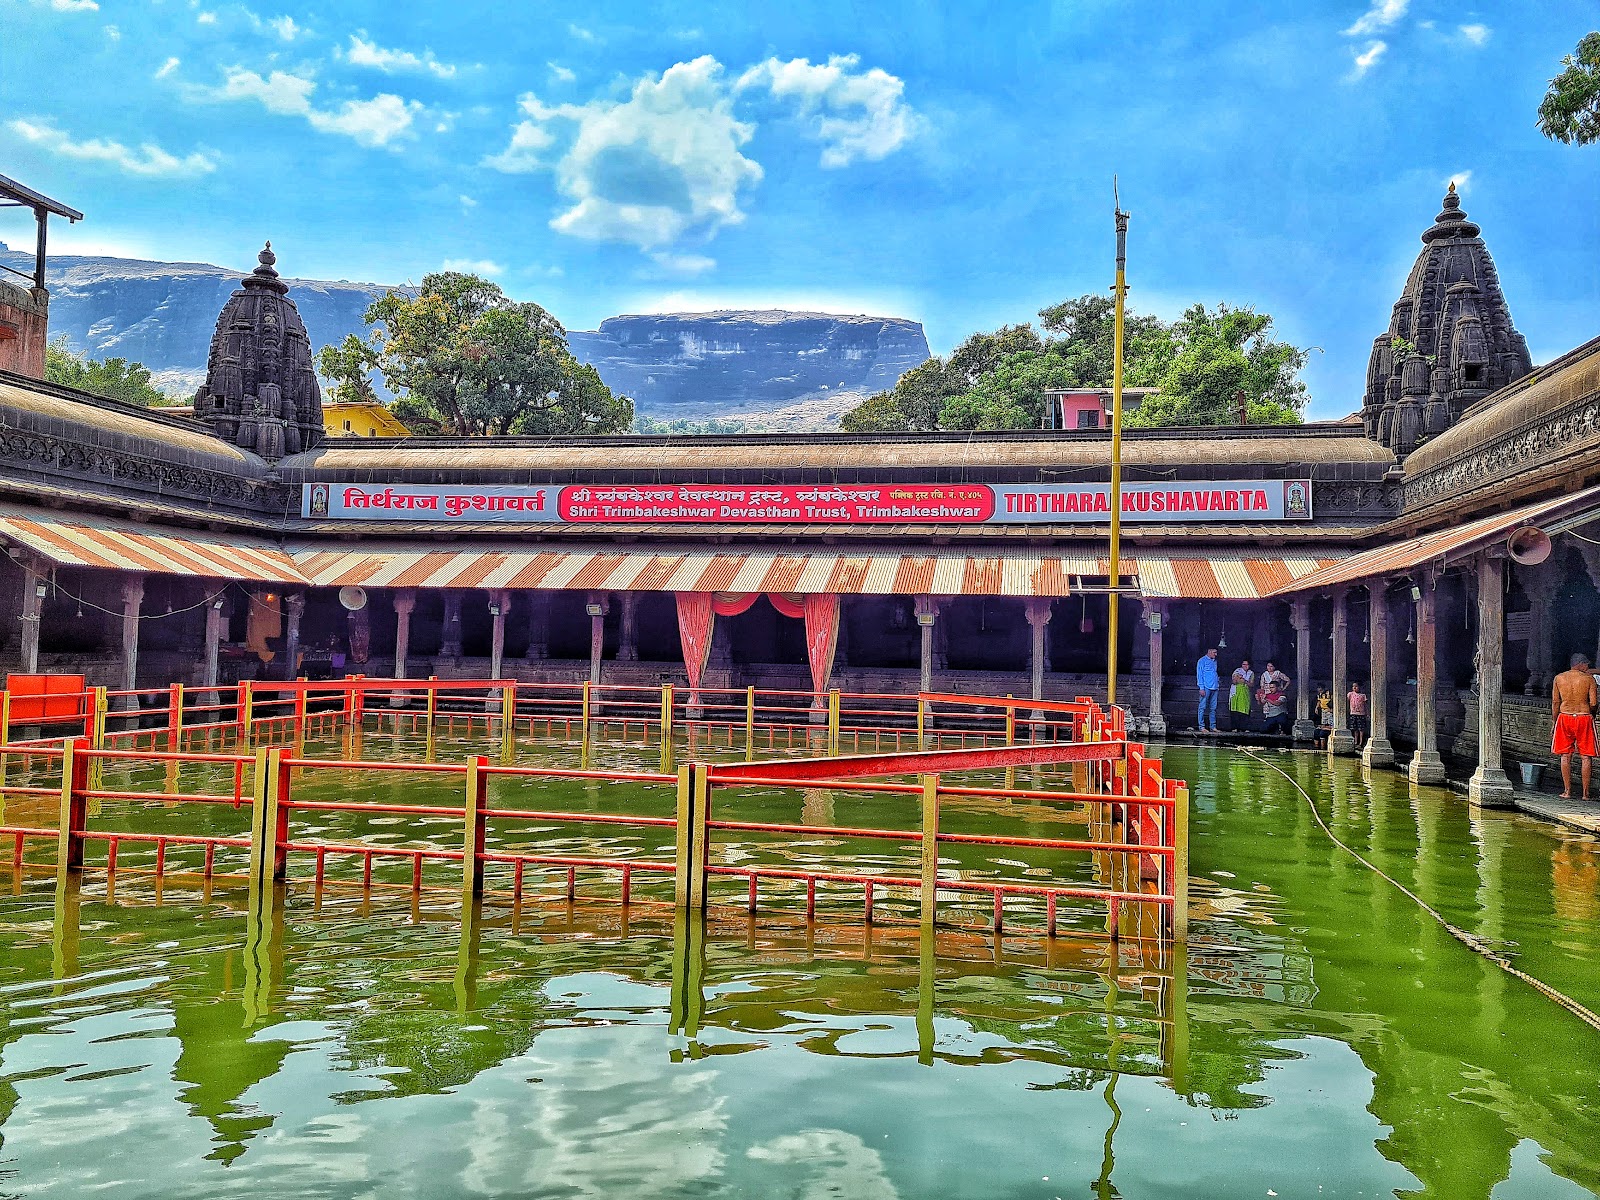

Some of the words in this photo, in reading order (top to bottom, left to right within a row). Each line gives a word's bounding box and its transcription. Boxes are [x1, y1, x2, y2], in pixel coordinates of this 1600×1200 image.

[444, 489, 546, 517] कुशावर्त
[571, 488, 591, 502] श्री
[678, 487, 745, 502] देवस्थान
[1121, 490, 1269, 512] KUSHAVARTA
[569, 505, 598, 517] Shri
[602, 505, 716, 518] Trimbakeshwar
[720, 505, 800, 518] Devasthan
[805, 505, 851, 520] Trust,
[856, 505, 981, 518] Trimbakeshwar
